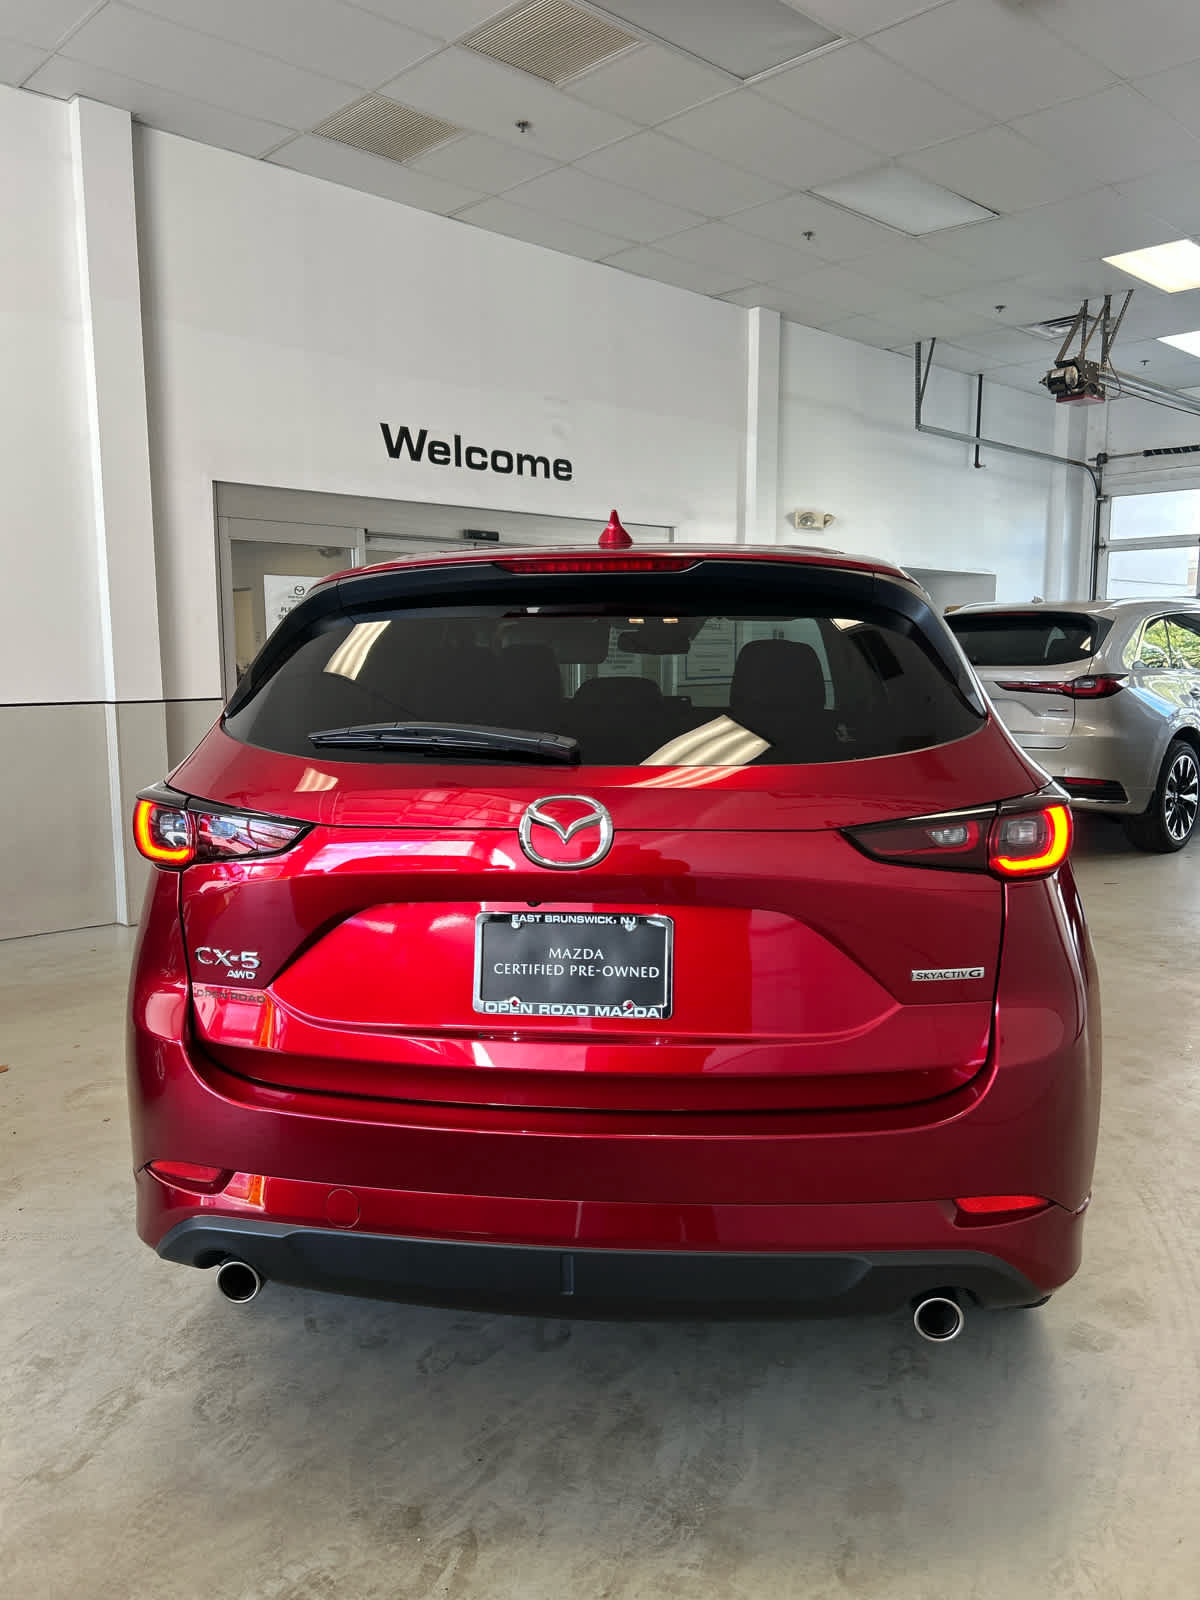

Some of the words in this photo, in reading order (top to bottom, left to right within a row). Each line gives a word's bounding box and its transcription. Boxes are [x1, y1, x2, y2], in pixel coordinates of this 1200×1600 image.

[380, 423, 573, 481] Welcome
[512, 914, 541, 923] EAST
[545, 915, 616, 924] BRUNSWICK,
[195, 946, 260, 969] CX-5
[548, 948, 604, 960] MAZDA
[226, 970, 256, 980] AWD
[494, 963, 564, 976] CERTIFIED
[569, 965, 660, 978] PRE-OWNED
[196, 989, 228, 999] OPEN
[230, 992, 266, 1003] ROAD
[485, 1002, 533, 1013] OPEN
[538, 1005, 589, 1016] ROAD
[594, 1007, 660, 1018] MAZDA
